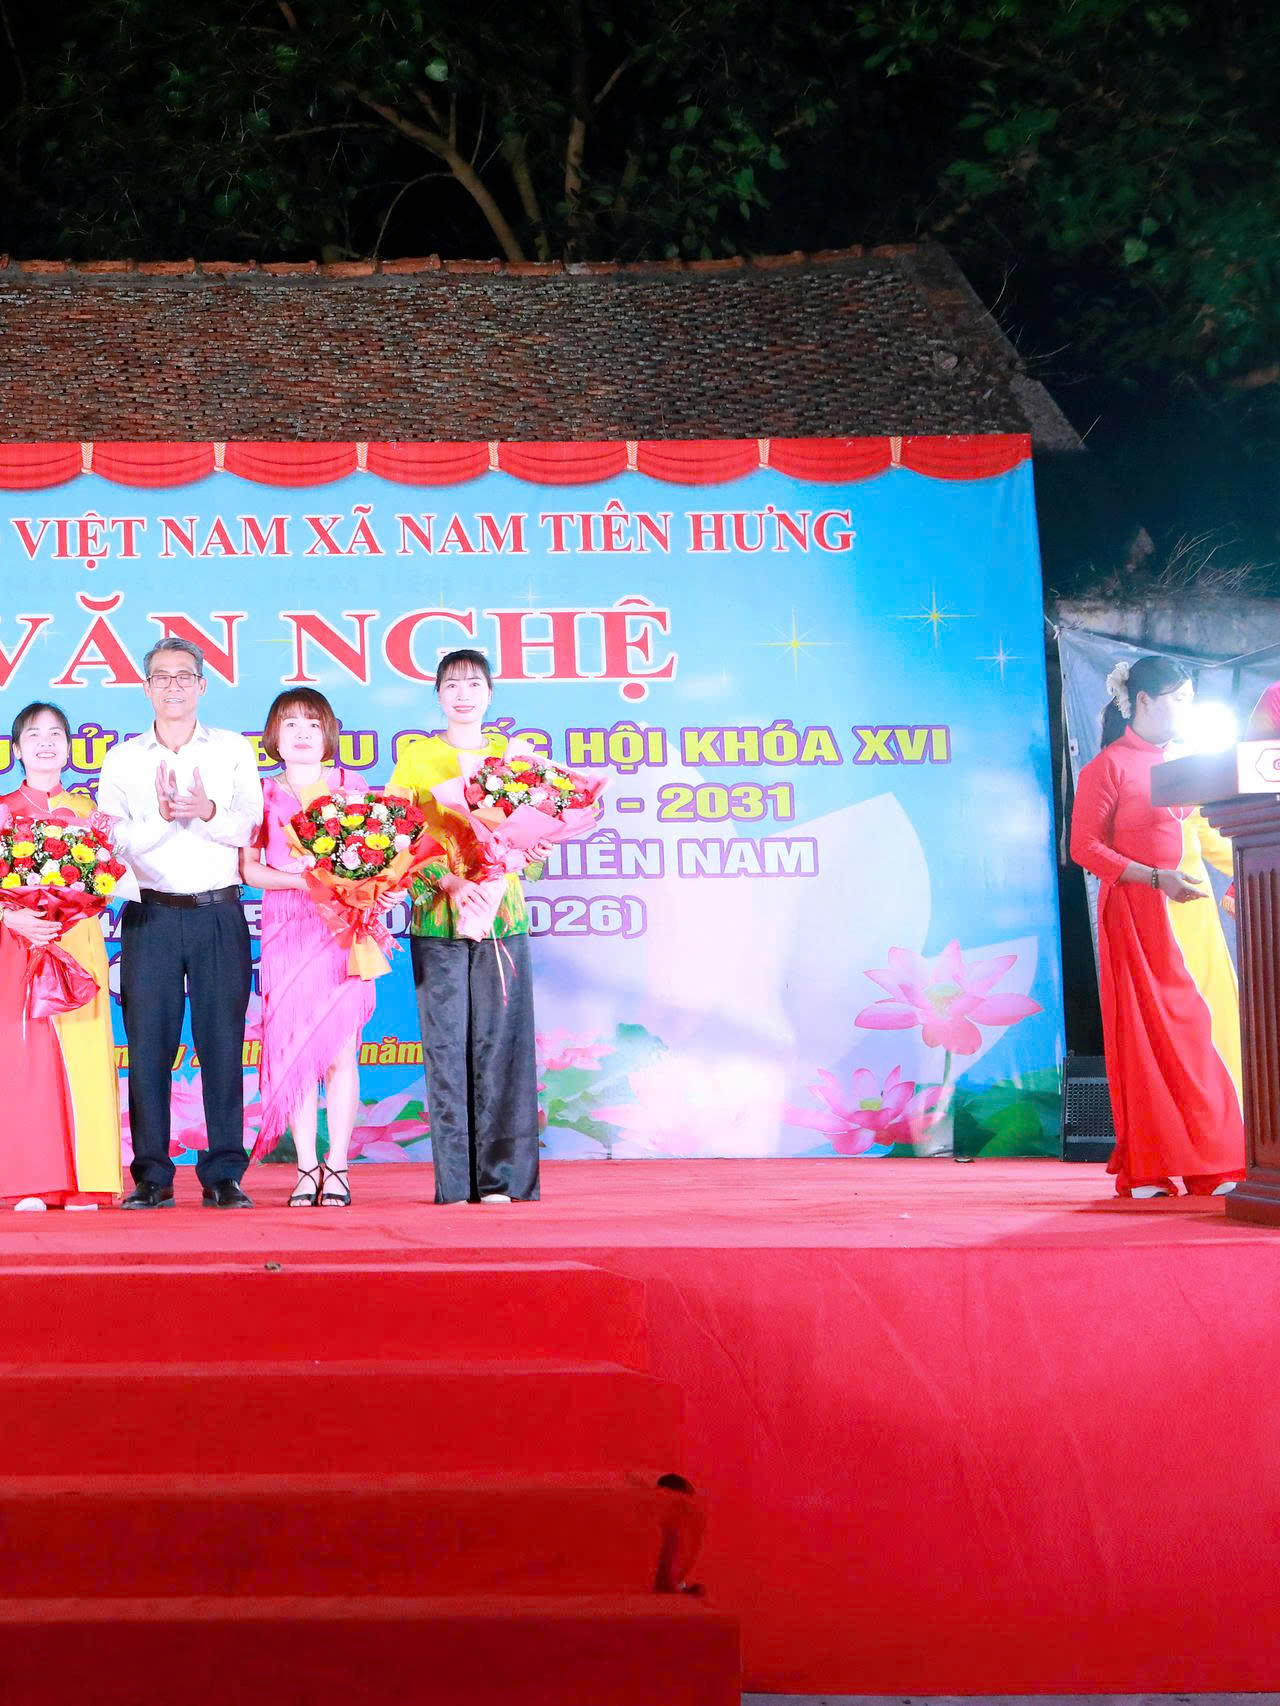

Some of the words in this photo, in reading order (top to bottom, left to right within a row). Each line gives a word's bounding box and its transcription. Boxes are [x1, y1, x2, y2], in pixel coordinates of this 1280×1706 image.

[11, 511, 145, 569] VIỆT
[160, 515, 290, 558] NAM
[303, 505, 384, 556] XÃ
[396, 511, 524, 556] NAM
[539, 501, 672, 554] TIÊN
[686, 504, 856, 553] HƯNG
[281, 596, 677, 703] NGHỆ
[567, 722, 666, 773] HỘI
[681, 721, 842, 766] KHÓA
[854, 726, 951, 764] XVI
[658, 783, 794, 821] 2031
[680, 838, 818, 877] NAM
